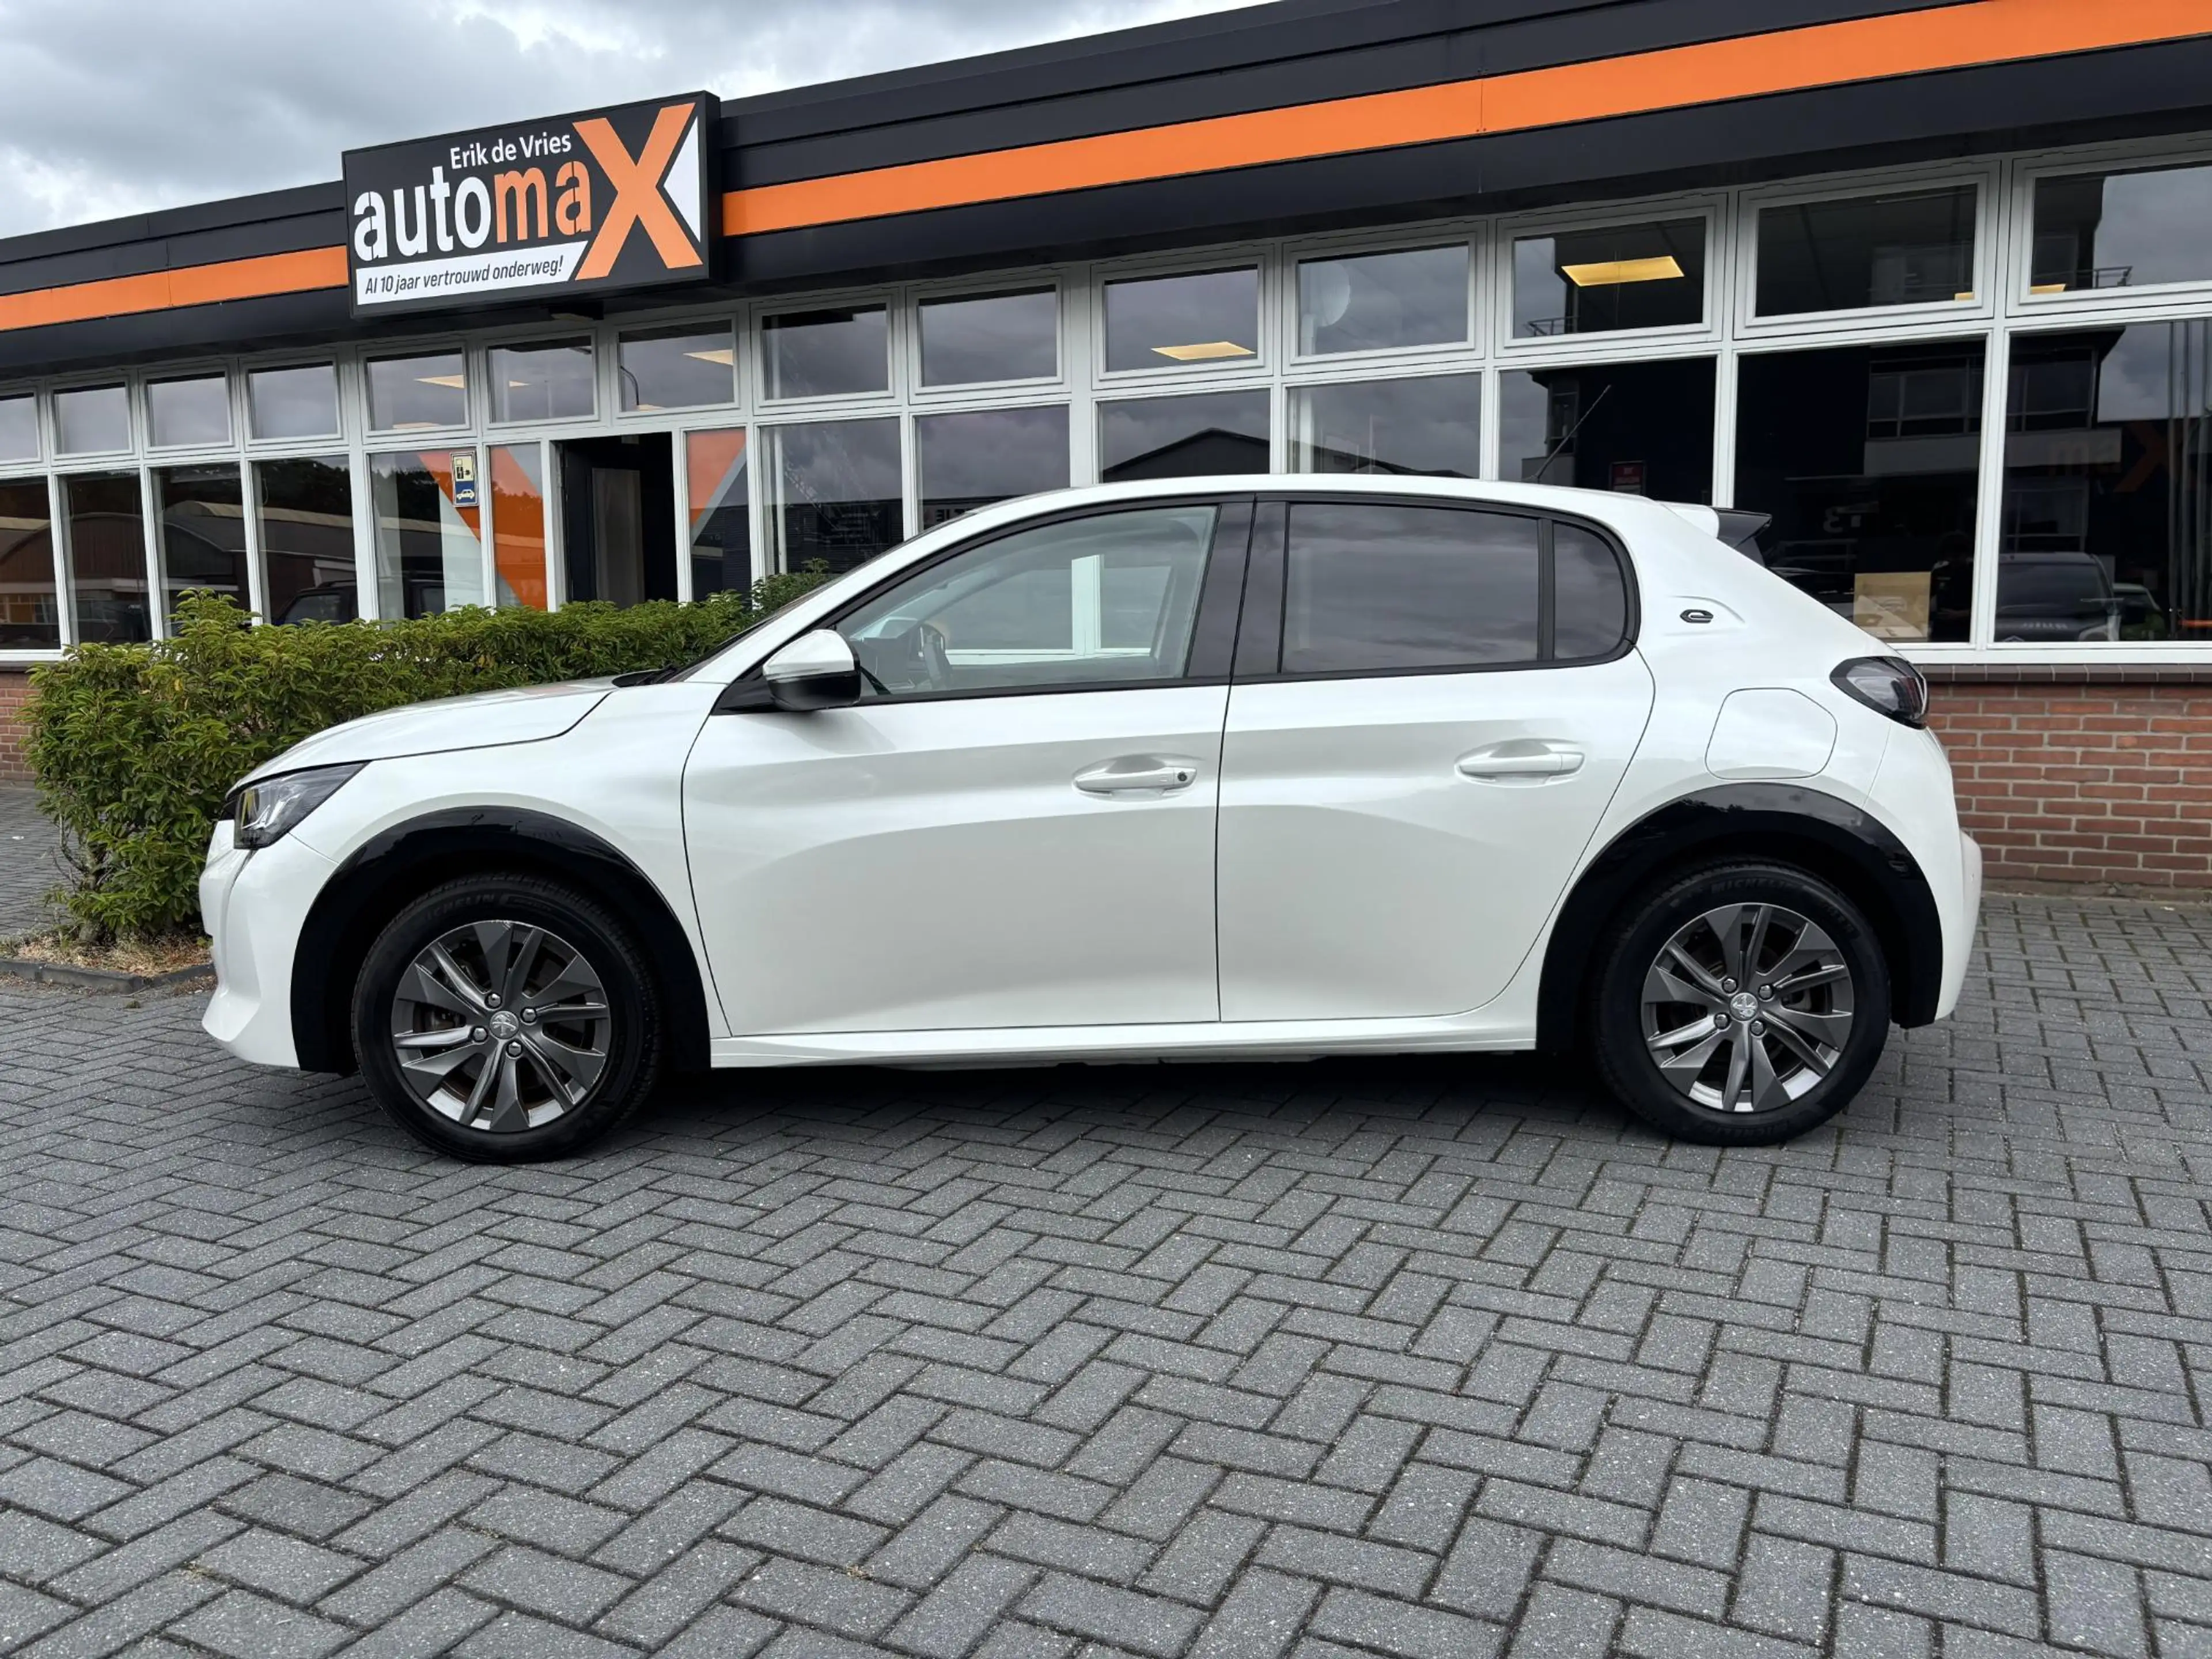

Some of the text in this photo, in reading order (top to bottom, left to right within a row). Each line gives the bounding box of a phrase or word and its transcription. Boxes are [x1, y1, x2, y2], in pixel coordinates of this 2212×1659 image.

[450, 131, 571, 169] Erik de Vries
[365, 255, 563, 294] Al 10 jaar vertrouwd onderweg!
